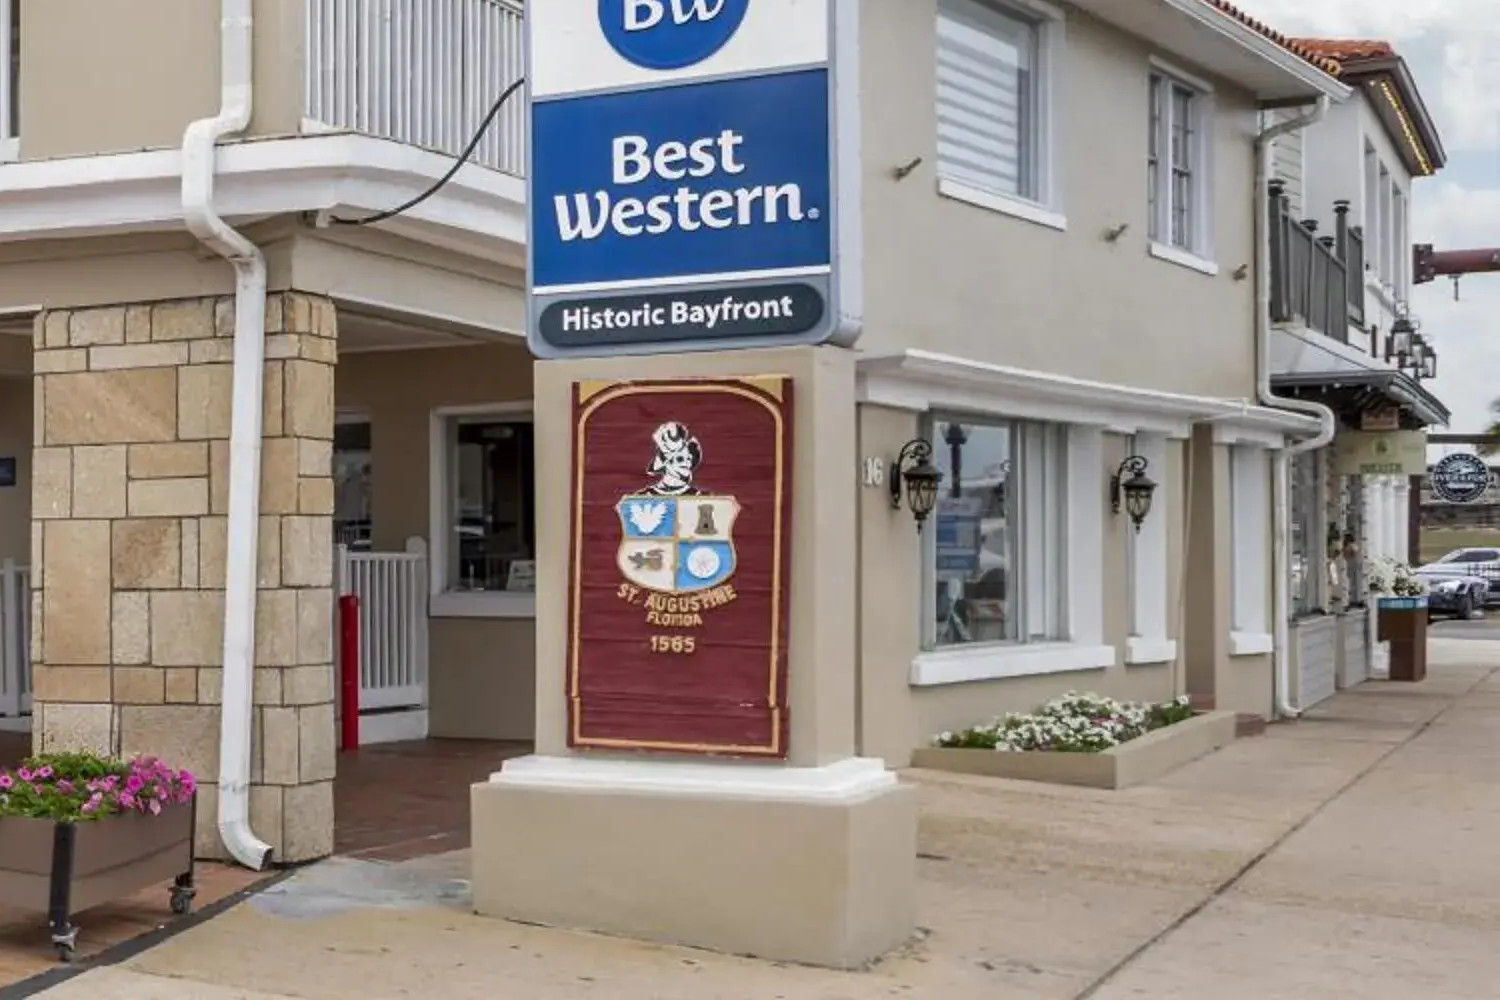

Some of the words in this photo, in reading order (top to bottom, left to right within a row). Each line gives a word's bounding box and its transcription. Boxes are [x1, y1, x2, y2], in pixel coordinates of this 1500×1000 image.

[612, 129, 744, 184] Best
[563, 303, 664, 331] Historic
[672, 296, 793, 328] Bayfront
[644, 584, 737, 613] AUGUSTINE
[651, 635, 695, 653] 1565
